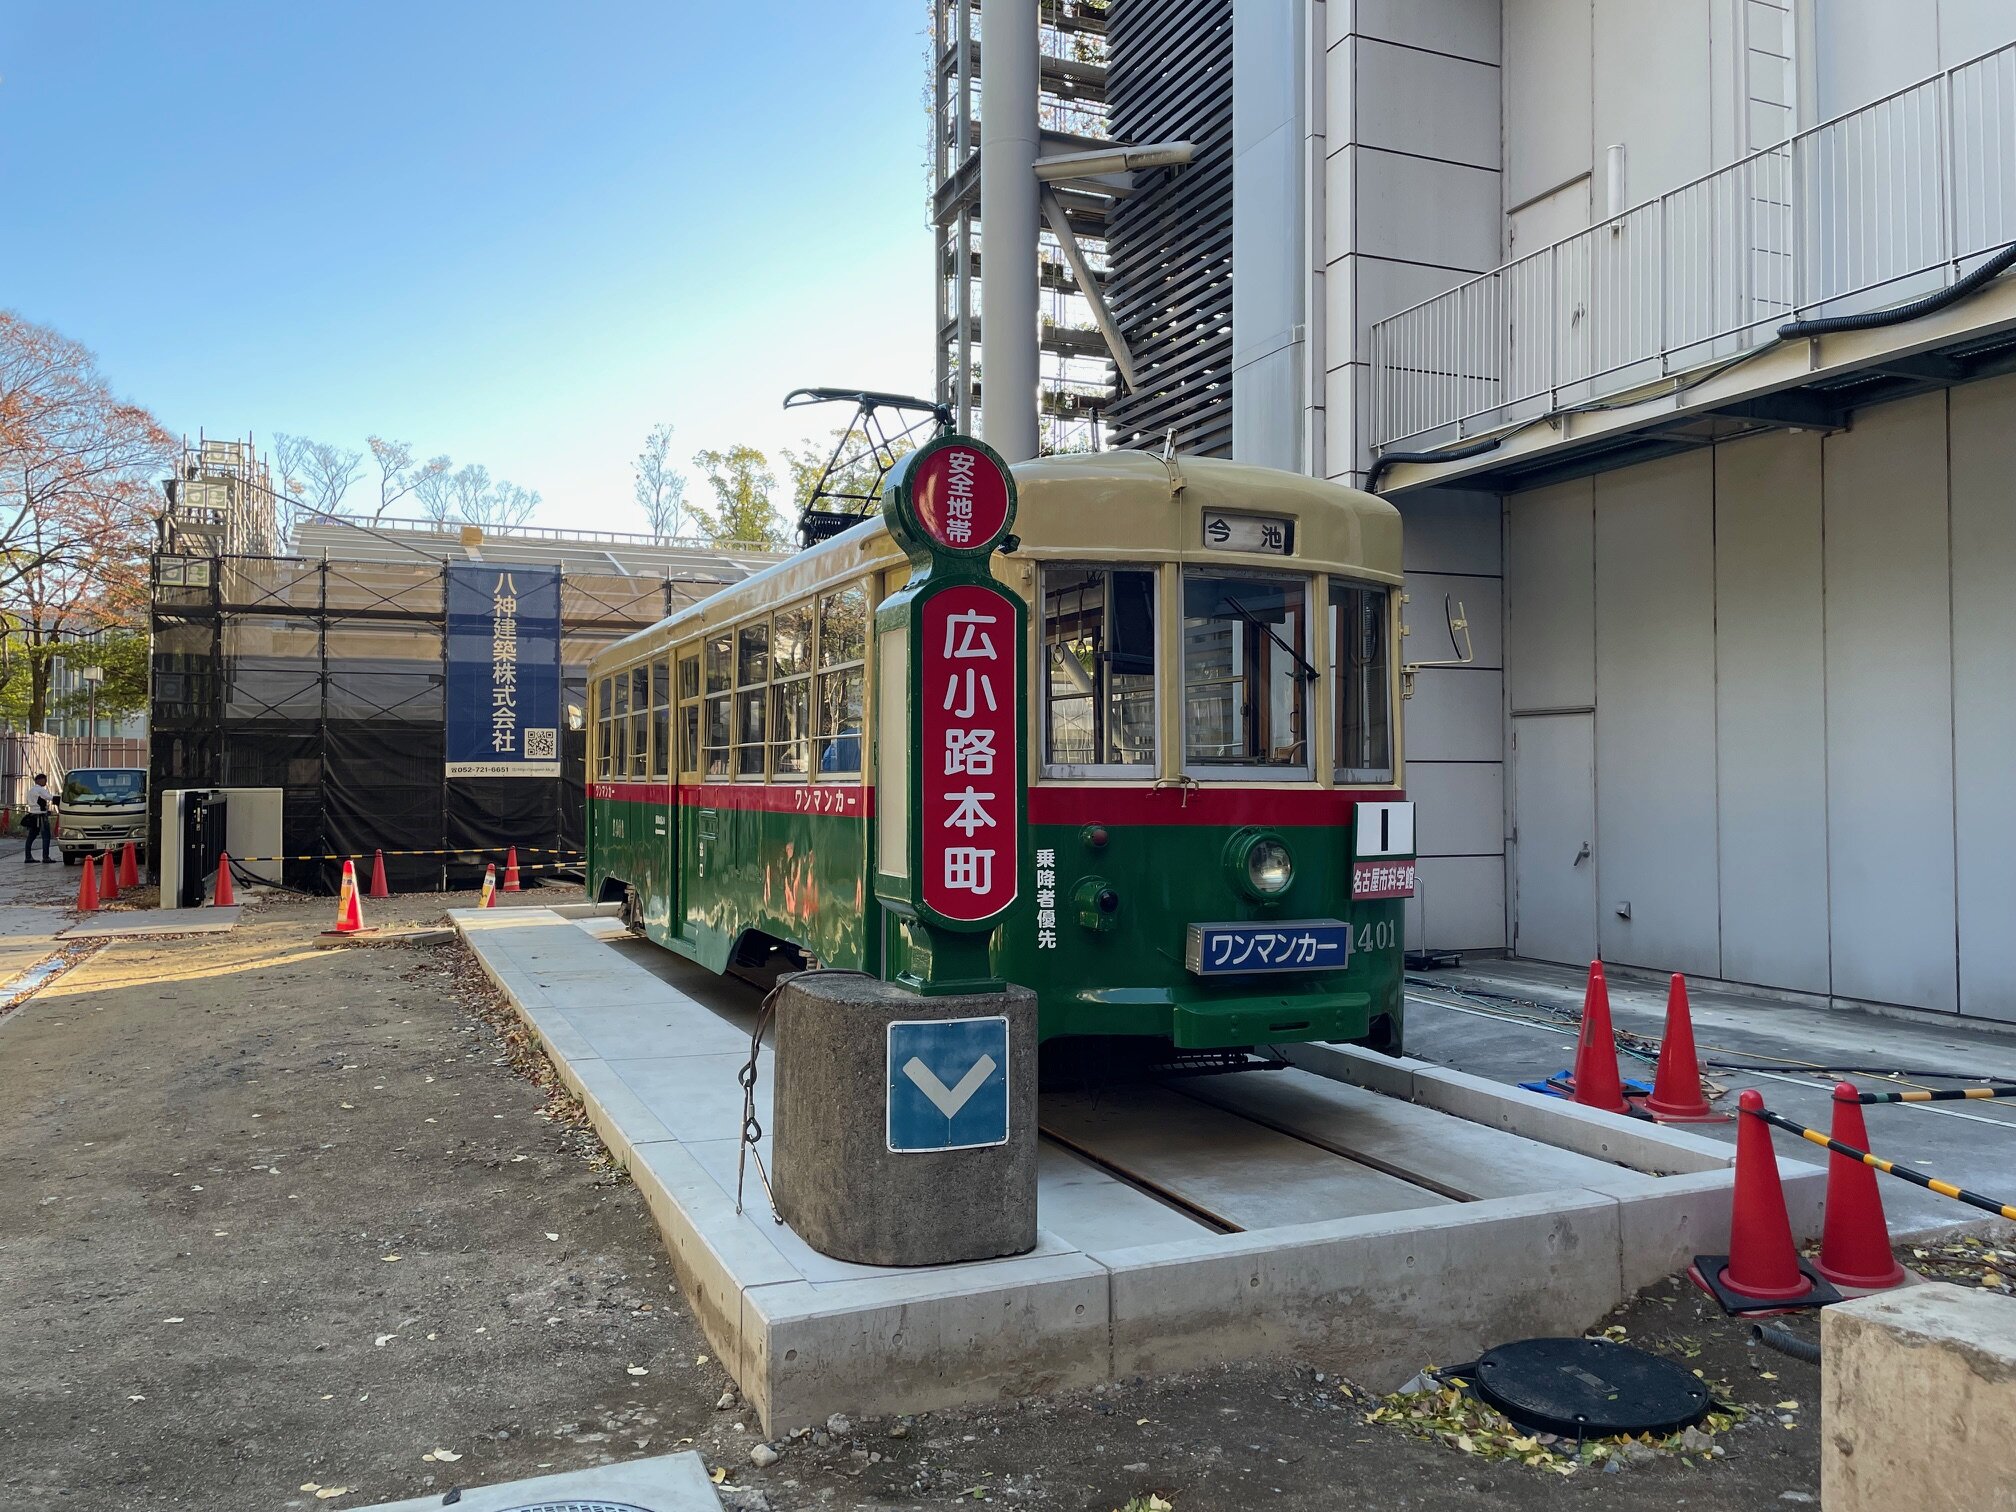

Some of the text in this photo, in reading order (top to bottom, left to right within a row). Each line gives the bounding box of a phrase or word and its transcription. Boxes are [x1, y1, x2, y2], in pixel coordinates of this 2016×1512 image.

[946, 451, 975, 543] 安全地帯
[492, 572, 518, 752] 八神建築株式会社
[942, 608, 997, 896] 広小路本町
[794, 789, 856, 813] ワンマンカー
[1036, 848, 1056, 949] 乗降者優先
[1353, 865, 1415, 893] 名古屋市科学館
[1212, 932, 1338, 966] ワンマンカー
